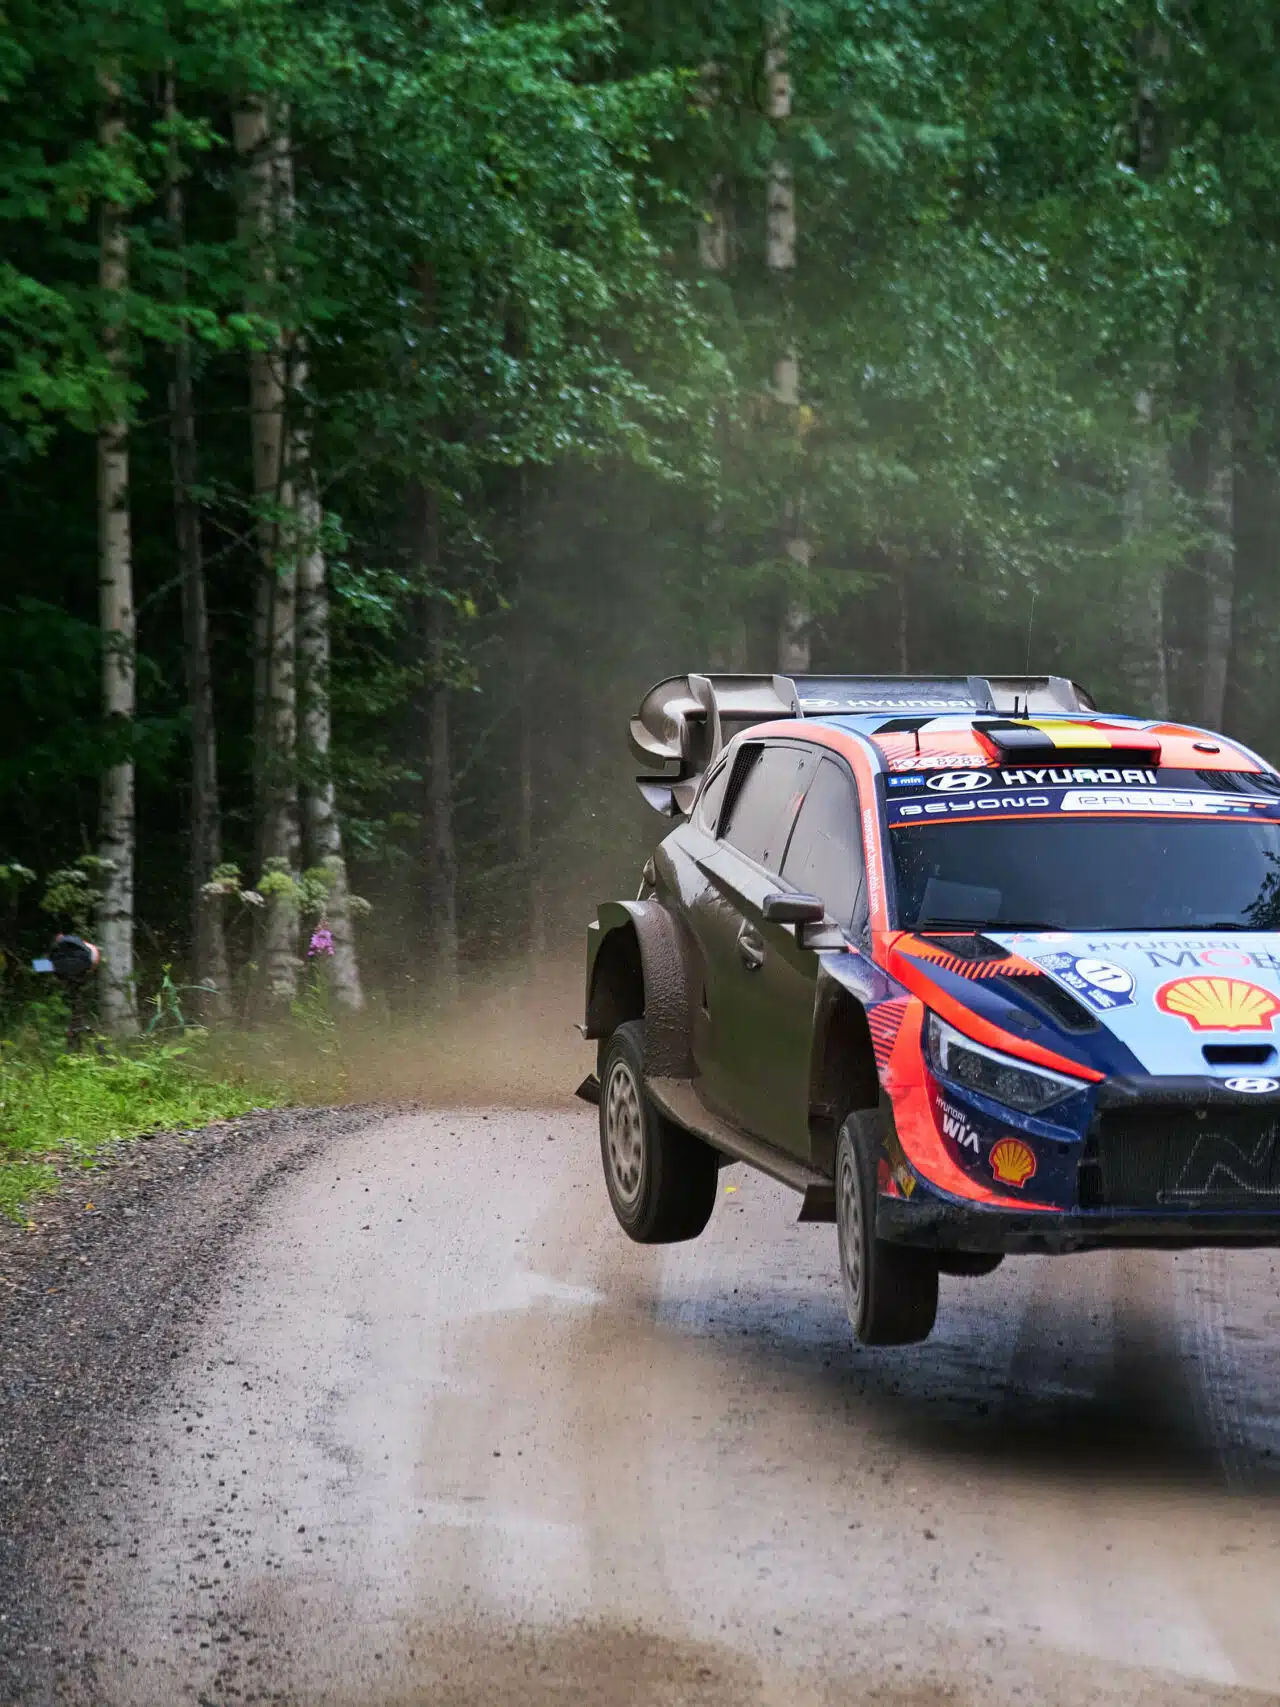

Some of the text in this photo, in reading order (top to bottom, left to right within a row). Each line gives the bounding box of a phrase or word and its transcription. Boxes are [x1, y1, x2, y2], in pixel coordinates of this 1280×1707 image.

[844, 699, 977, 708] HYUNDAI
[1000, 769, 1158, 786] HYUNDAI
[899, 796, 1195, 816] BEYOND RALLY
[1086, 941, 1241, 952] HYUNDAI
[1087, 966, 1123, 982] 11
[936, 1096, 968, 1124] HYUNDAI
